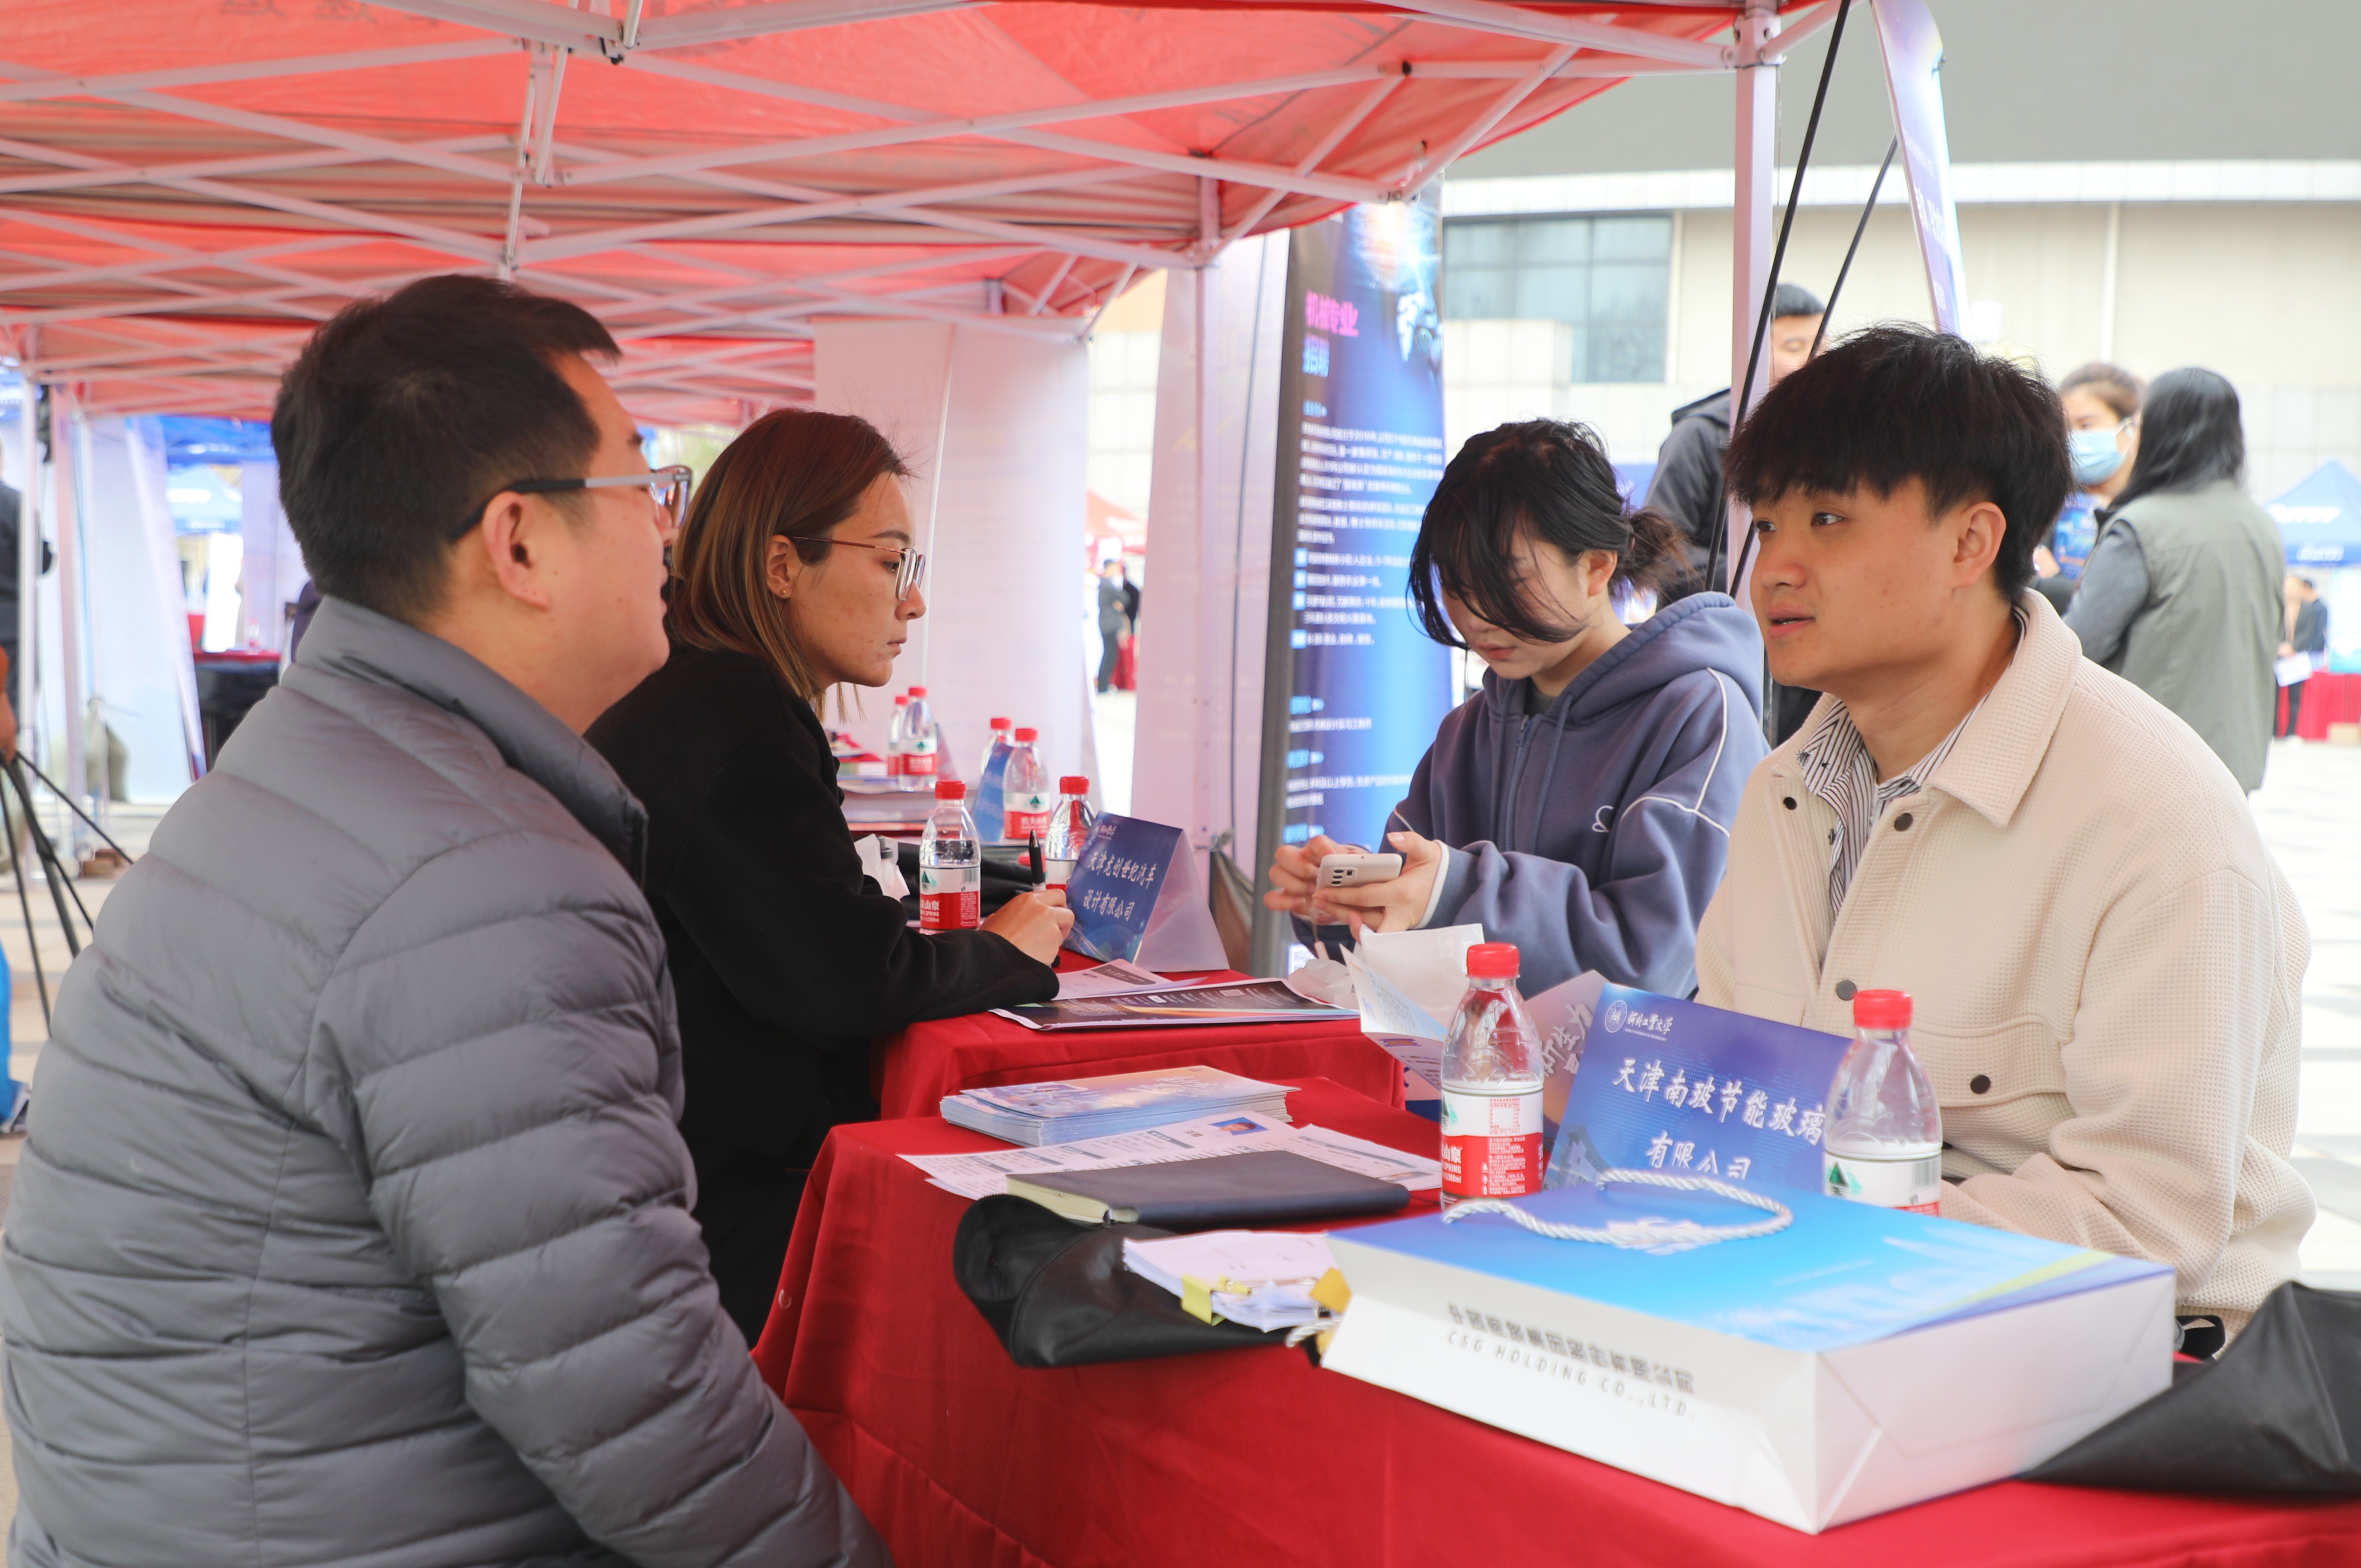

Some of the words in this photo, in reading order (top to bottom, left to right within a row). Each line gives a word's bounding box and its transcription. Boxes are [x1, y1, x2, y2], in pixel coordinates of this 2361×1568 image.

[1083, 889, 1135, 921] 设计有限公司
[1613, 1059, 1826, 1147] 天津南玻节能玻璃
[1444, 1161, 1462, 1175] SPRING
[1647, 1129, 1752, 1180] 有限公司
[1448, 1330, 1483, 1353] CSG
[1495, 1343, 1587, 1386] HOLDING
